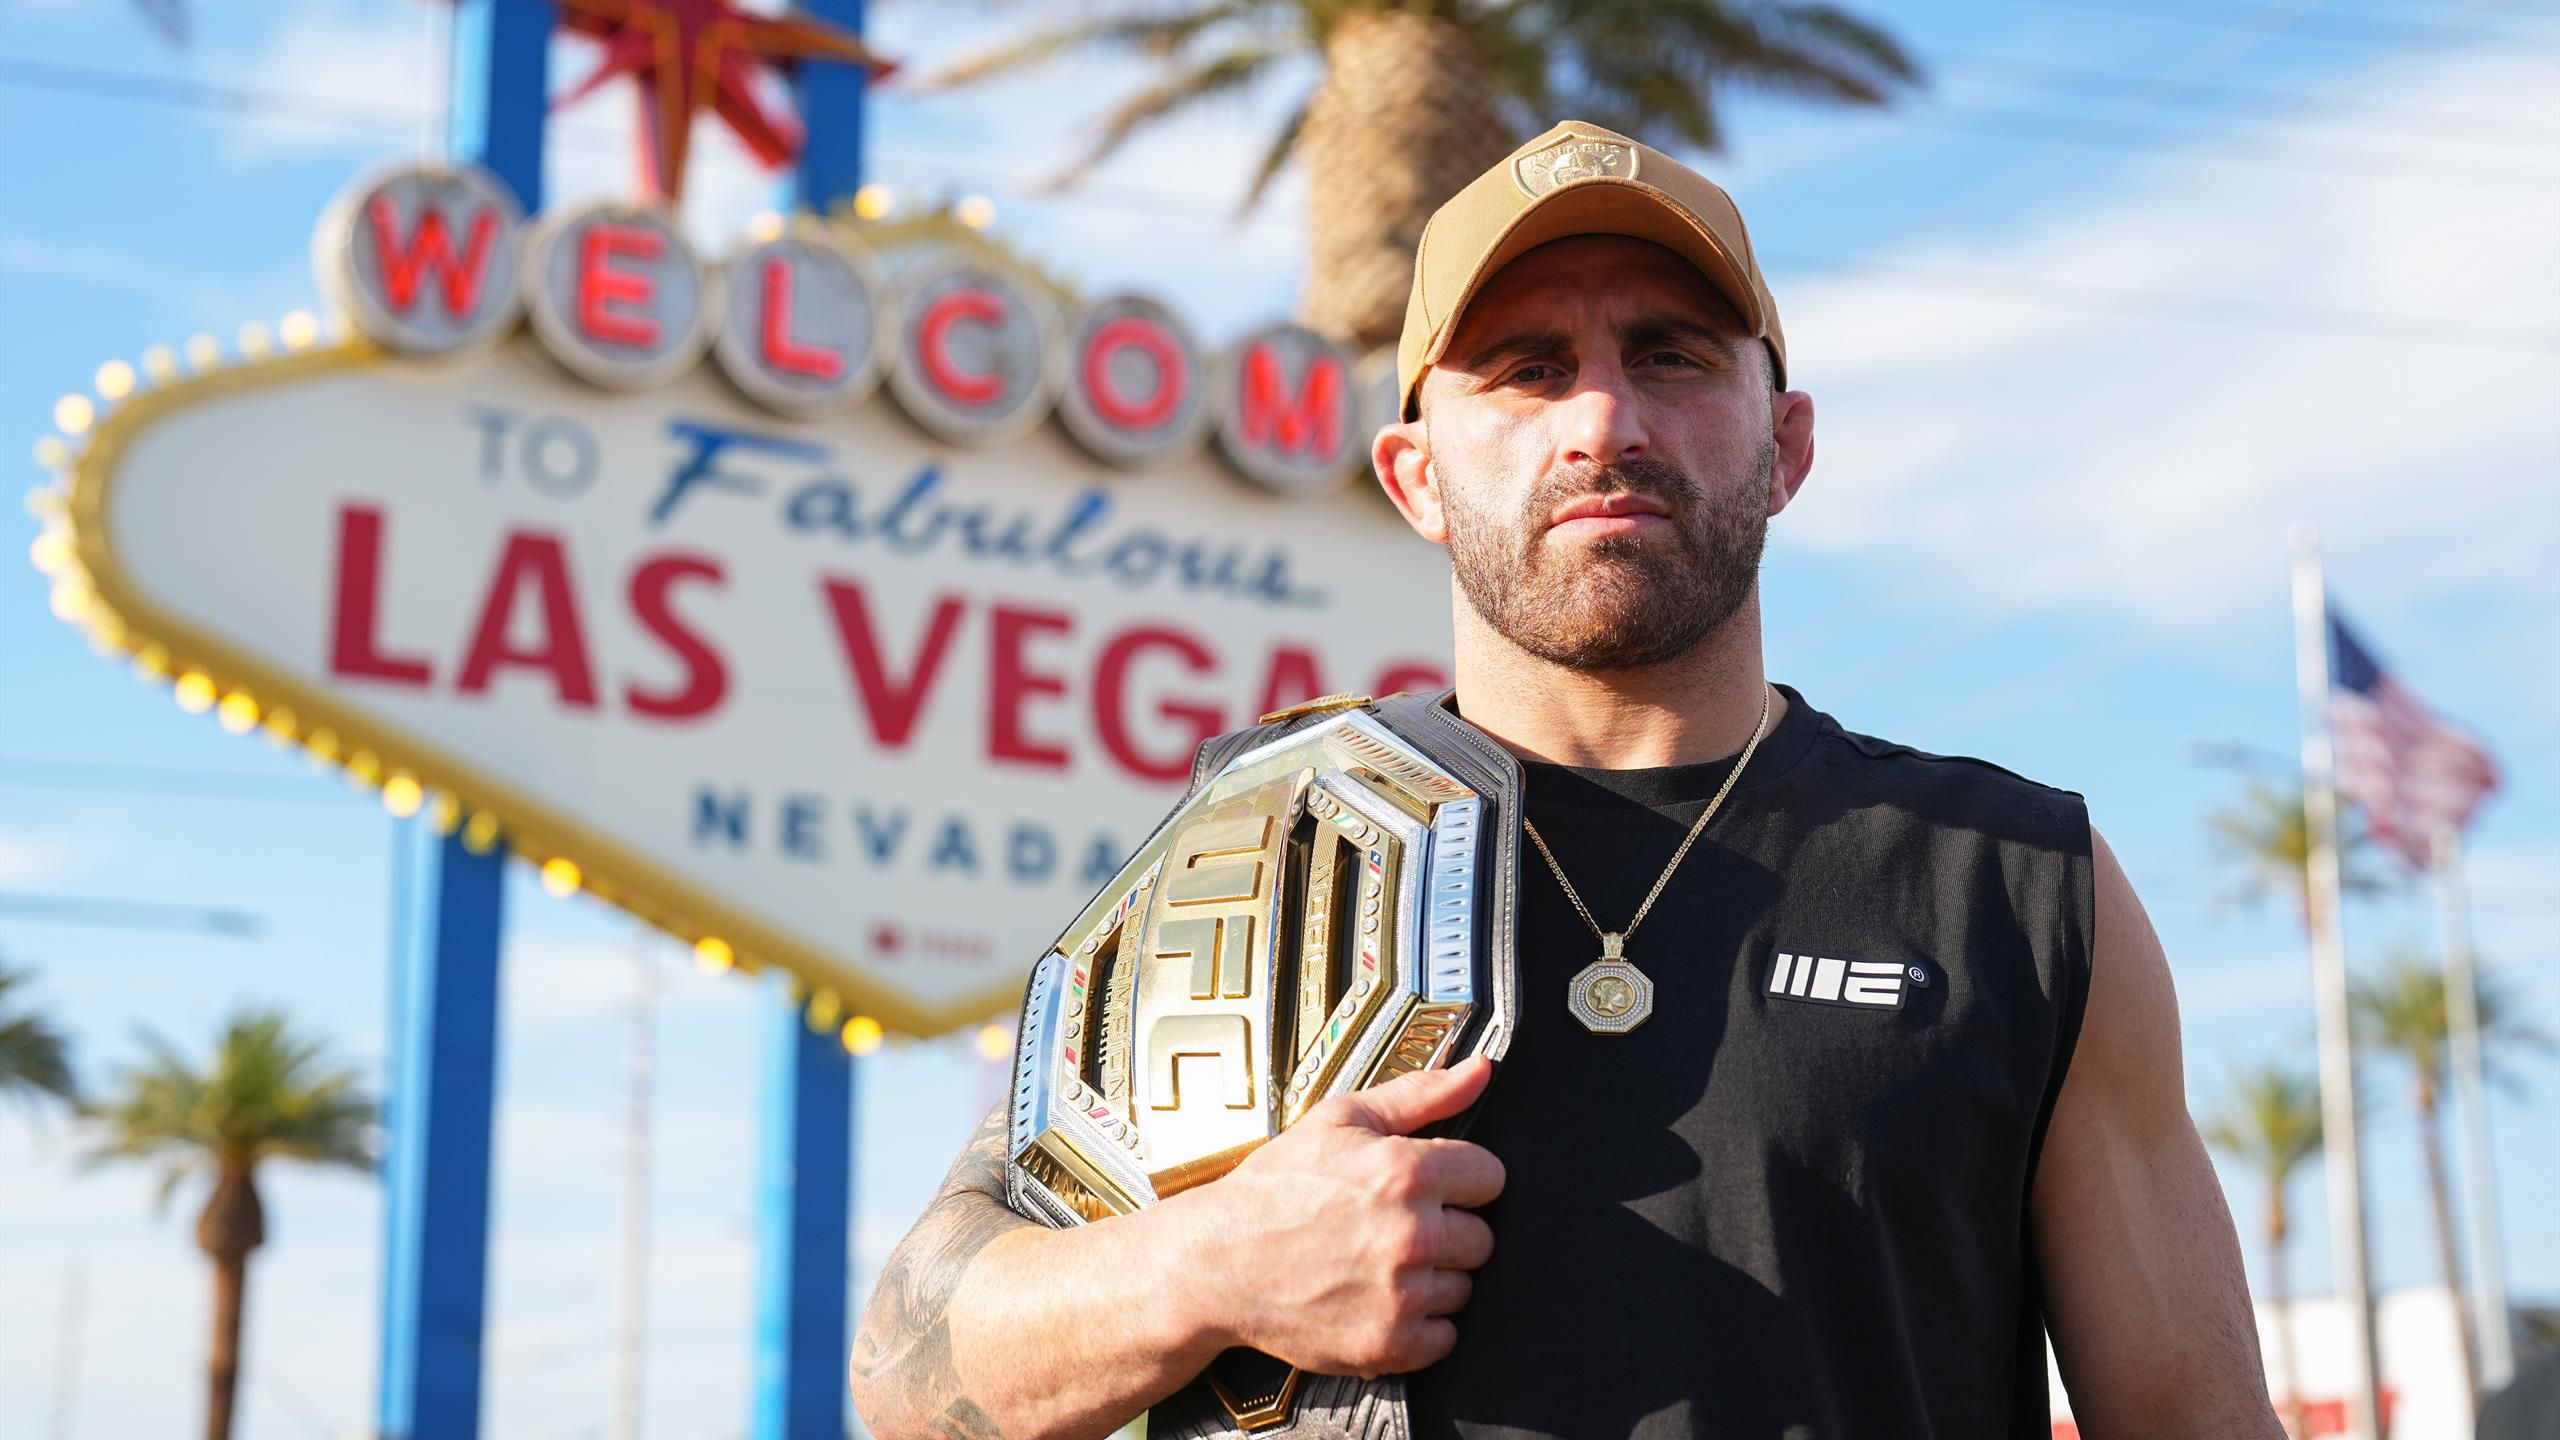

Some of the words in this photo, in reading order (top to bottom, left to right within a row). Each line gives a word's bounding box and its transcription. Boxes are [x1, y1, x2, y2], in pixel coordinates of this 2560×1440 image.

[368, 192, 1344, 463] WELCOM
[464, 405, 600, 499] TO
[648, 418, 1330, 606] Fabulous
[328, 500, 732, 724] LAS
[693, 786, 1122, 884] NEVADA
[1305, 858, 1332, 1012] WORLD
[1109, 911, 1142, 1100] CHAMPION
[1151, 815, 1274, 1111] UFC
